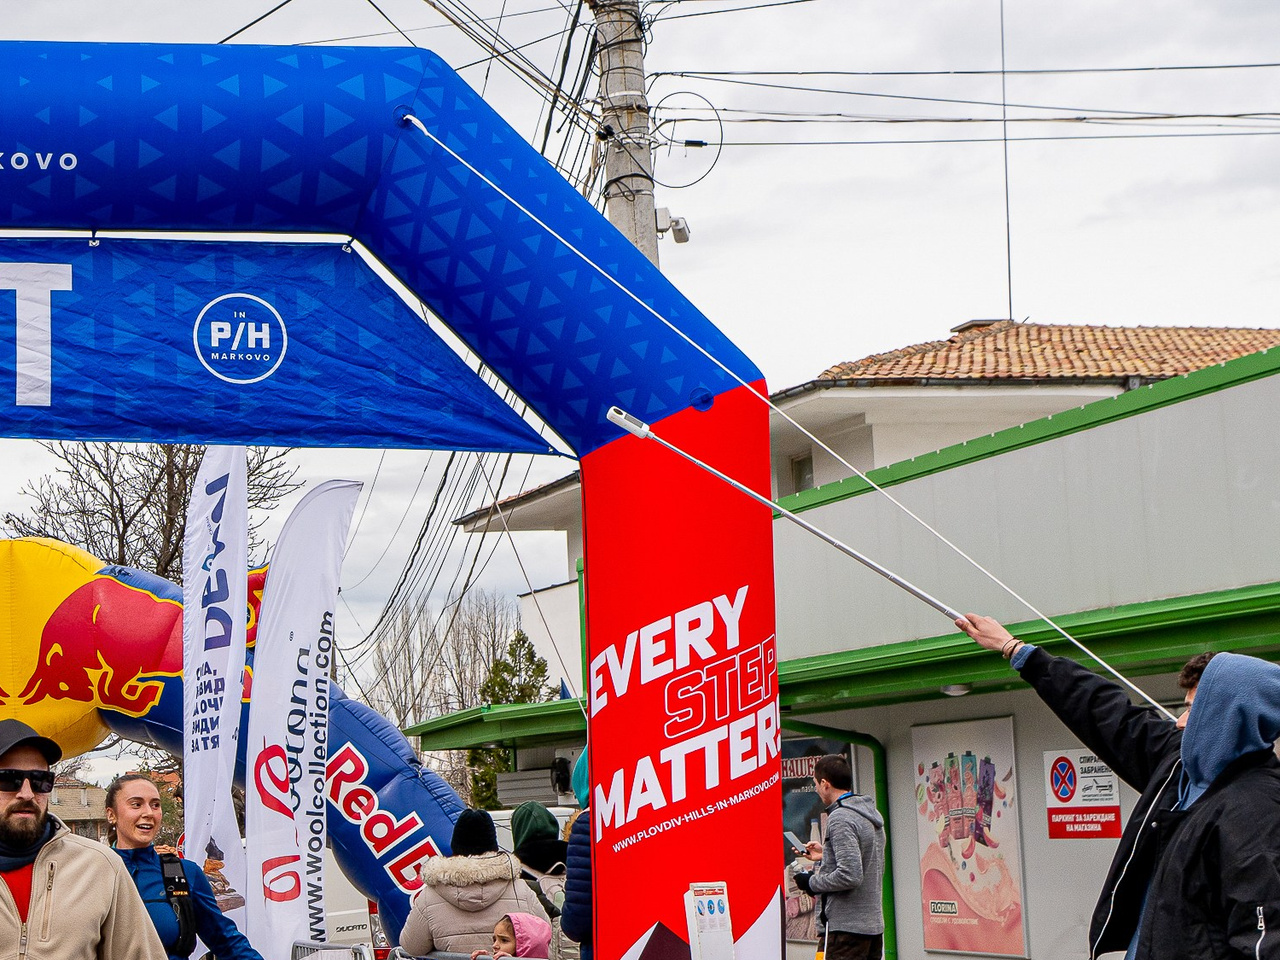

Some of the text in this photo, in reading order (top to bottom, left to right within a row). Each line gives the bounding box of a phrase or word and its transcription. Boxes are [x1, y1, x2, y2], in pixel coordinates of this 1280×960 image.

[210, 321, 271, 351] P/H
[210, 352, 271, 362] MARKOVO
[233, 311, 246, 319] IN
[590, 584, 750, 719] EVERY
[663, 633, 778, 740] STEP
[306, 610, 334, 942] www.woolcollection.com
[325, 741, 424, 858] Red
[612, 770, 780, 854] WWW.PLOVDIV-HILLS-IN-MARKOVO.COM
[931, 901, 957, 914] FLORINA
